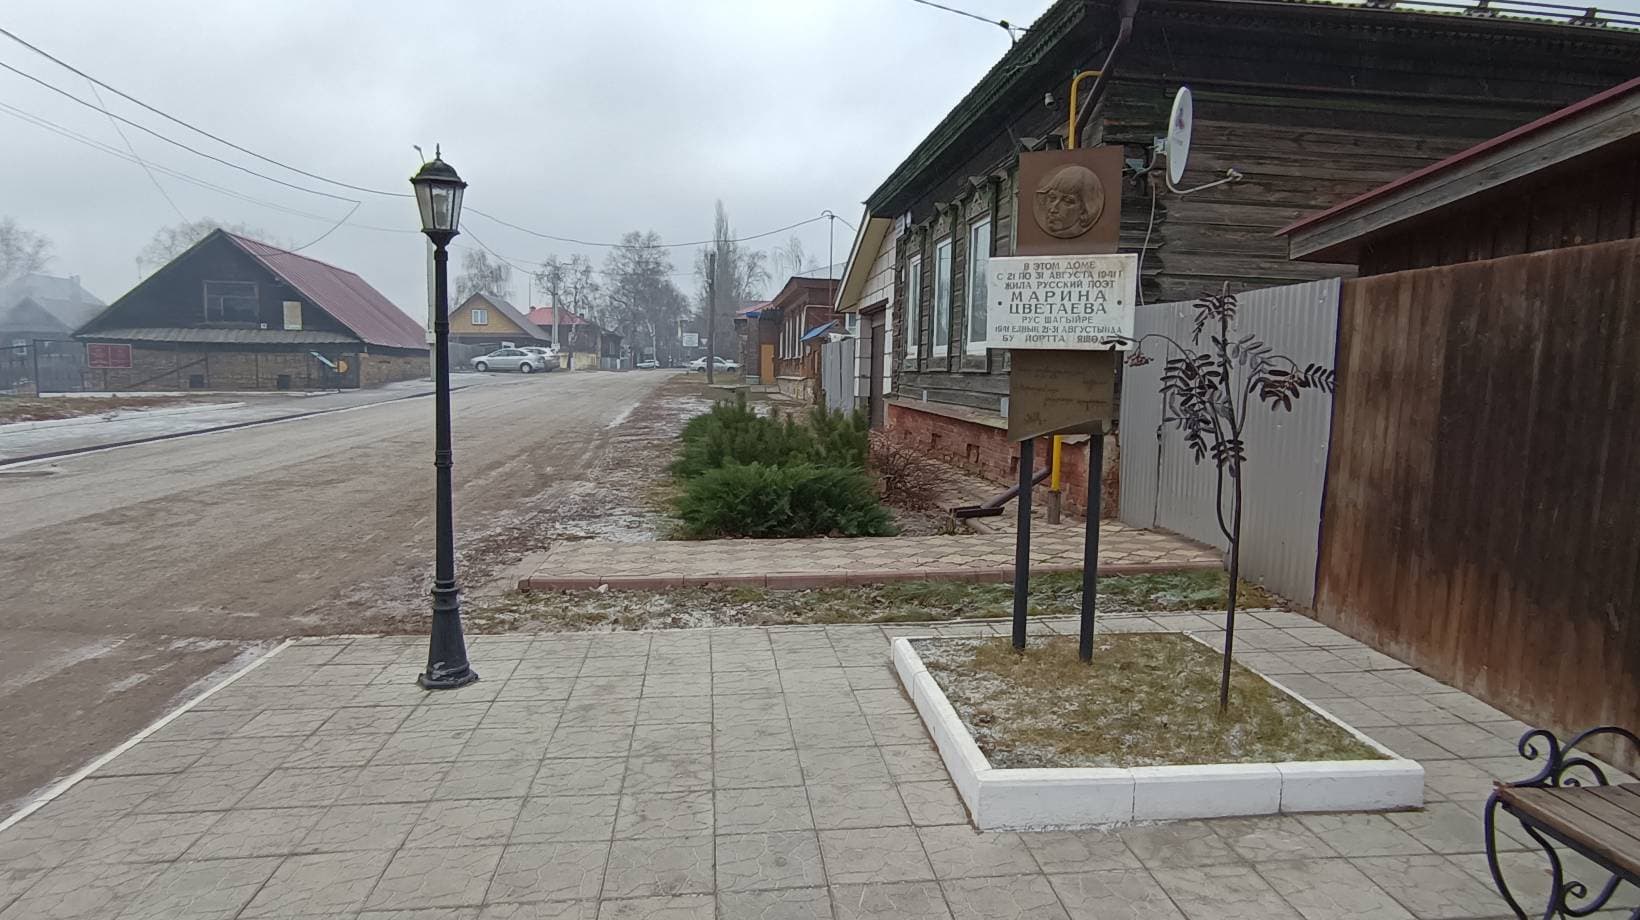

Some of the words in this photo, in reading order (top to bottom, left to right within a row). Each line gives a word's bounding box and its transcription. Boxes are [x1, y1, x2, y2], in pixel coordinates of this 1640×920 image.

[1023, 262, 1030, 271] В
[1033, 262, 1060, 271] ЭТОМ
[1065, 261, 1096, 270] ДОМЕ
[996, 272, 1004, 281] С
[1006, 272, 1016, 281] 21
[1018, 272, 1032, 281] ПО
[1035, 271, 1044, 280] 31
[1049, 271, 1094, 280] АВГУСТА
[1005, 281, 1032, 290] ЖИЛА
[1036, 279, 1083, 290] РУССКИЙ
[1088, 280, 1116, 289] ПОЭТ
[1011, 290, 1107, 303] МАРИНА
[1009, 303, 1107, 315] ЦВЕТАЕВА
[1021, 316, 1041, 324] РУС
[1044, 315, 1094, 324] ШАГЫЙРЕ
[1061, 325, 1122, 334] АВГУСТЫНДА
[1025, 334, 1065, 343] ЙОРТТА
